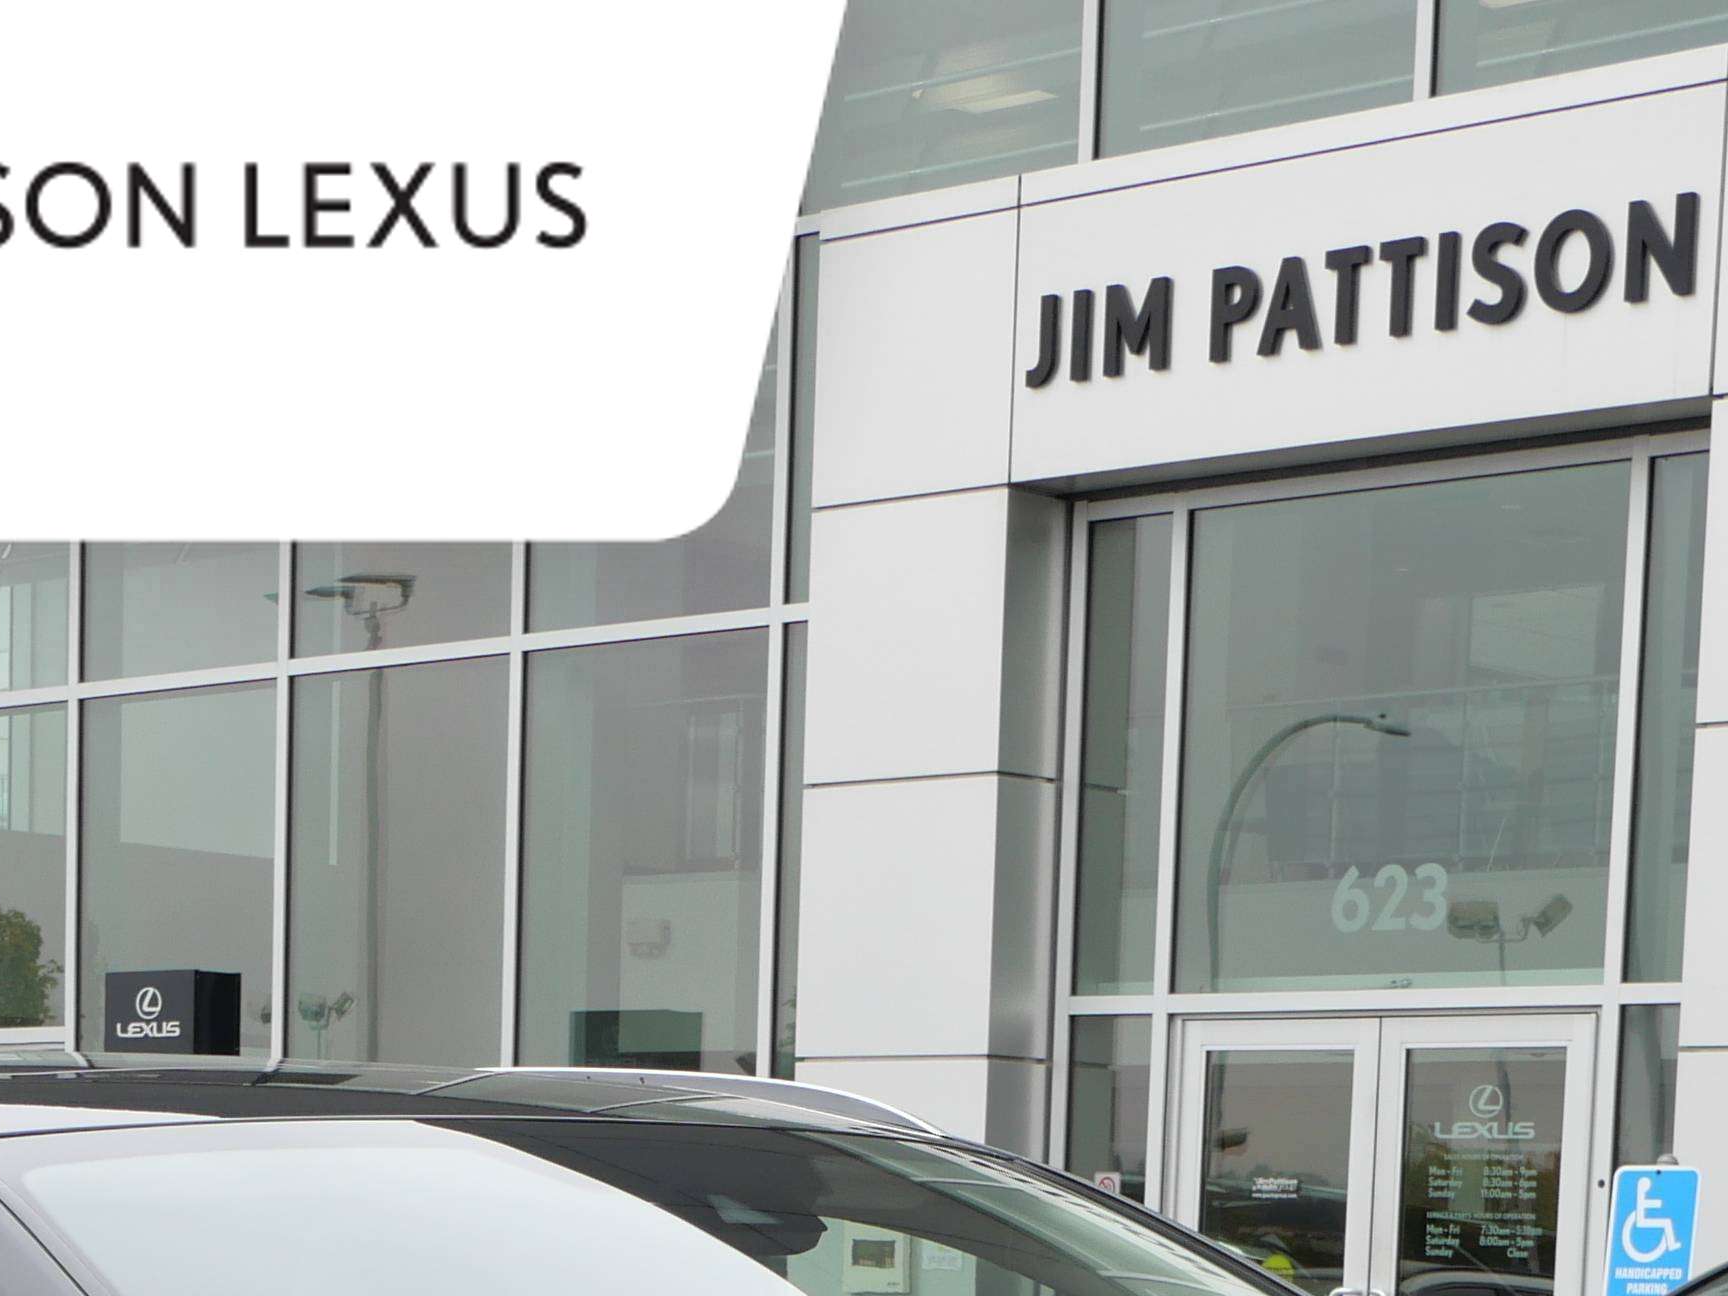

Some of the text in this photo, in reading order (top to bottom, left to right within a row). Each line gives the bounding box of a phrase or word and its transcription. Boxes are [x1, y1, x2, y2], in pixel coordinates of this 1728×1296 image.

[1025, 191, 1700, 388] JIM PATTISON
[1330, 861, 1450, 933] 623
[115, 1020, 181, 1039] LEXUS
[1433, 1122, 1536, 1141] LEXUS
[1428, 1176, 1462, 1188] Saturday
[1428, 1187, 1455, 1199] Sunday
[1426, 1235, 1460, 1247] Saturday
[1426, 1246, 1453, 1258] Sunday
[1615, 1267, 1682, 1280] HANDICAPPED
[1626, 1283, 1668, 1295] PARKING
